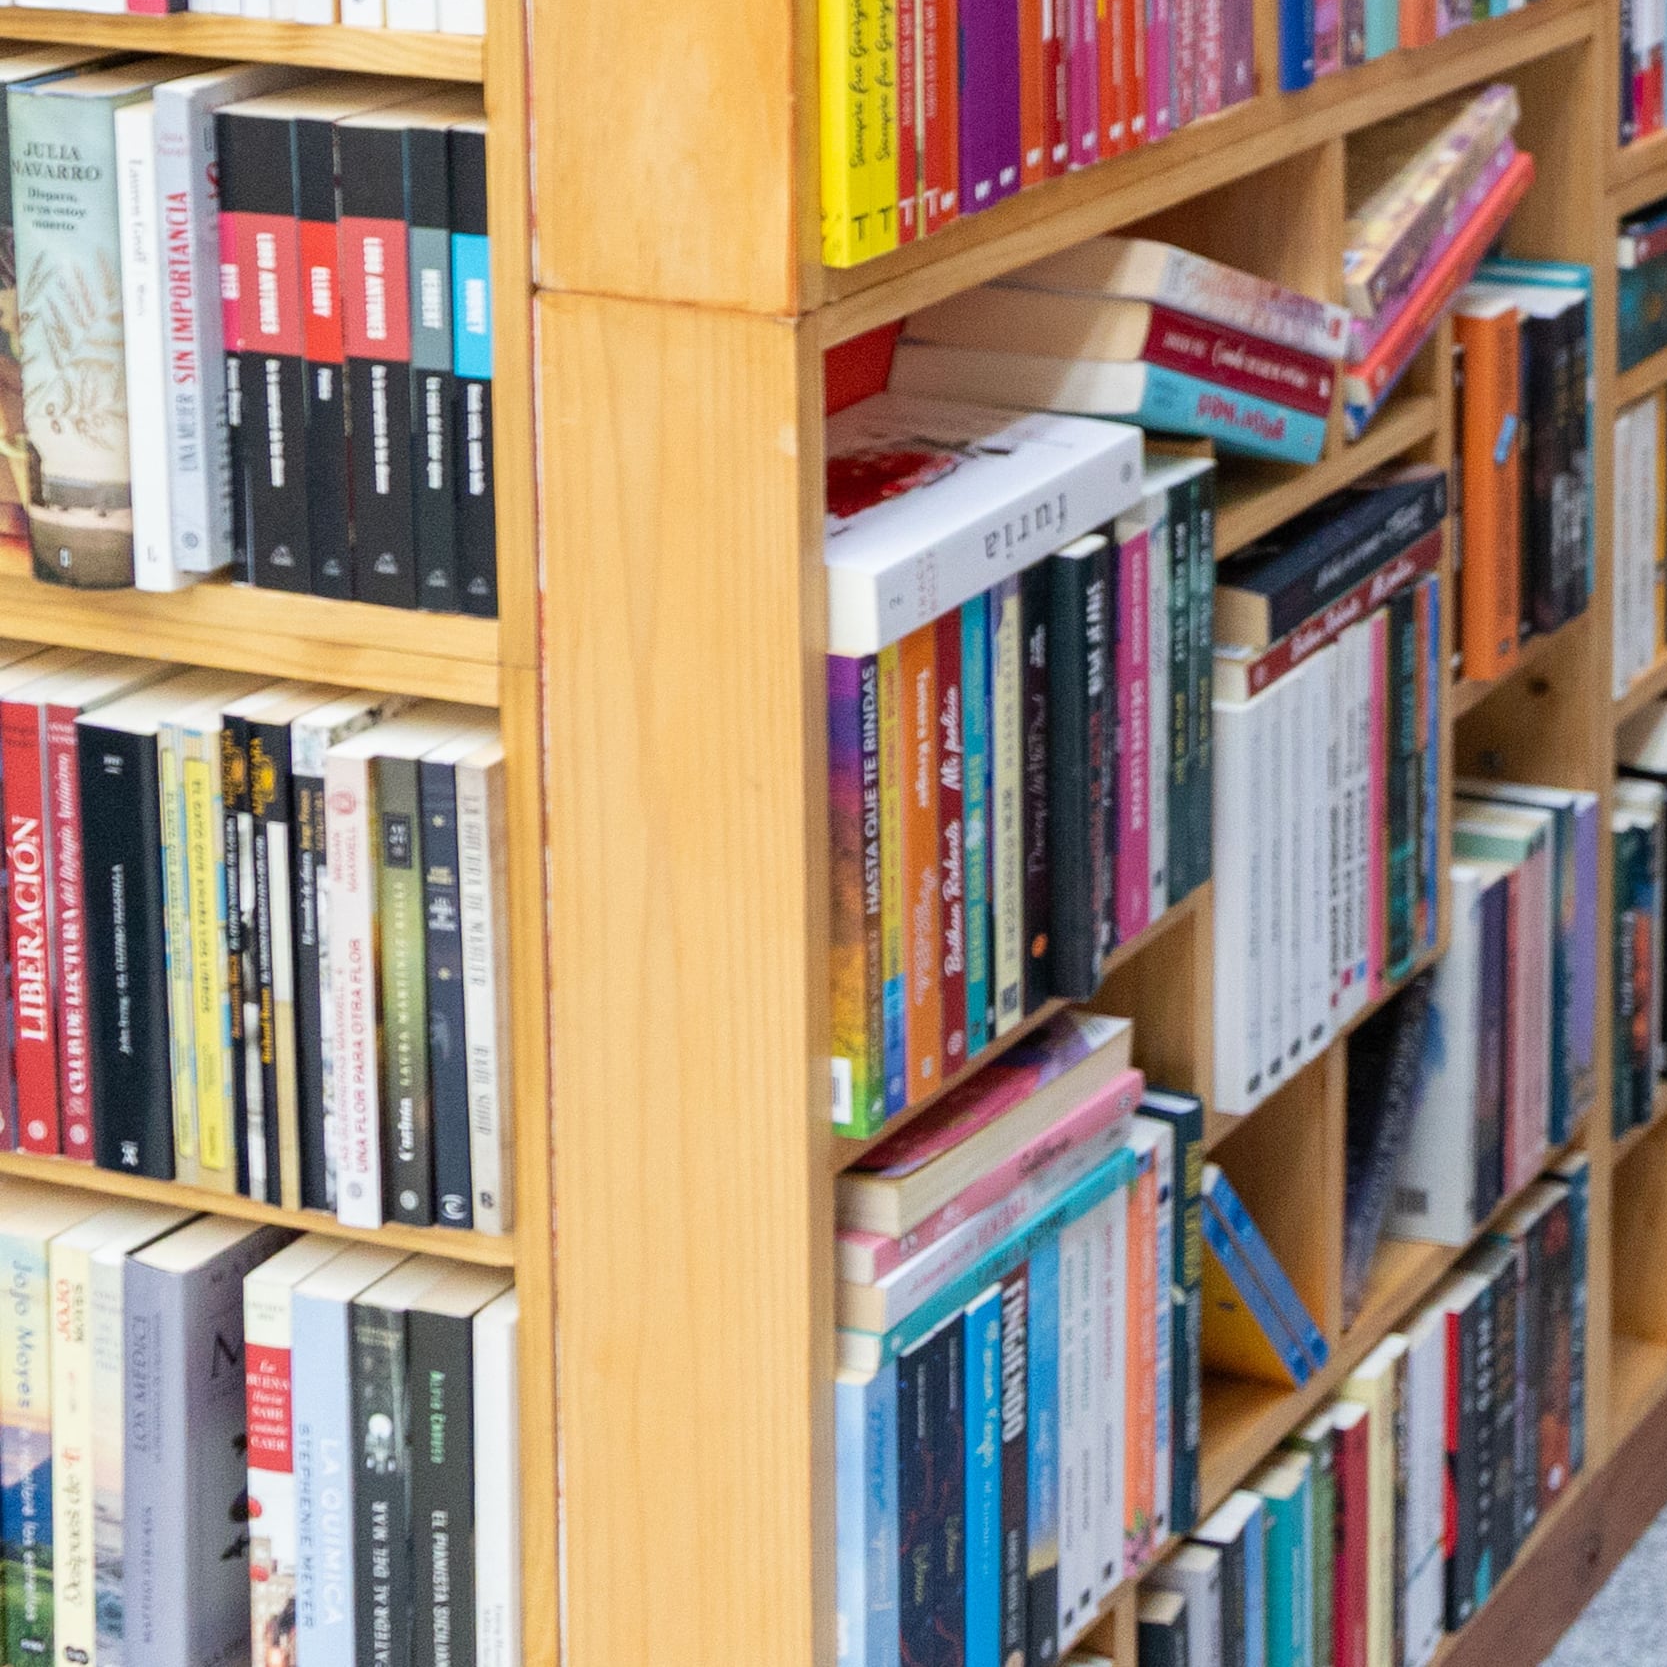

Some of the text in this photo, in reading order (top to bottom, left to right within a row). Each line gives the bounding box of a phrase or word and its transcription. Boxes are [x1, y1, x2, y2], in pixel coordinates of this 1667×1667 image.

[848, 65, 869, 96] fue
[873, 58, 893, 89] fue
[23, 142, 82, 161] JULIA
[848, 100, 867, 170] Siempre
[874, 94, 892, 162] Siempre
[10, 160, 101, 182] NAVARRO
[164, 192, 195, 343] IMPORTANCIA
[171, 349, 197, 385] SIN
[983, 491, 1069, 560] furia
[861, 663, 881, 916] HASTA QUE TE RINDAS
[939, 754, 962, 792] Mi
[941, 817, 963, 902] Roberts
[12, 816, 48, 1042] LIBERACIÓN
[61, 907, 82, 1005] LECTURA
[941, 901, 963, 977] Bethan
[348, 938, 369, 1174] UNA FLOR PARA OTRA FLOR
[8, 1259, 35, 1409] Jojo Moyes
[320, 1438, 341, 1477] LA
[298, 1423, 315, 1629] STEPHENIE MEYER
[371, 1500, 391, 1579] DEL MAR
